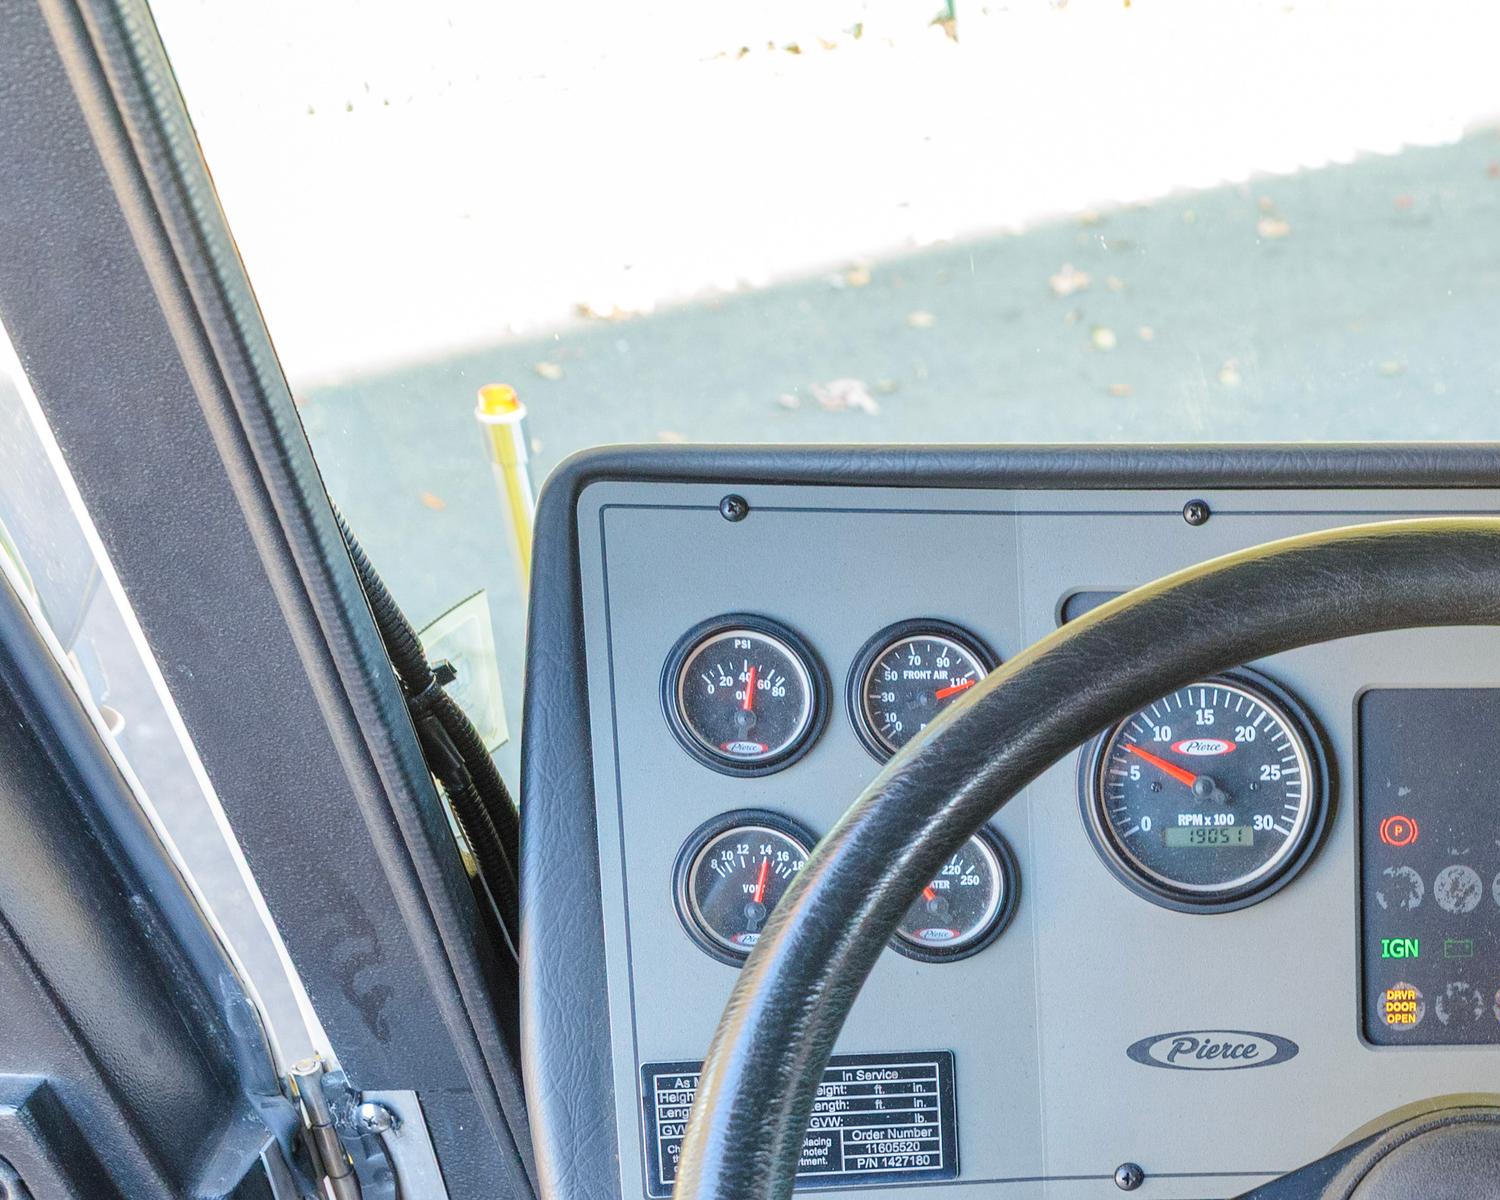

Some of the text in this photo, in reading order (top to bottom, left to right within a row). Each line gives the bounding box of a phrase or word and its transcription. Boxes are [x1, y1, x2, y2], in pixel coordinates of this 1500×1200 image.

[735, 640, 751, 649] PSI
[908, 656, 921, 666] 70
[936, 657, 950, 667] 90
[885, 671, 898, 681] 50
[903, 670, 948, 680] FRONT AIR
[719, 676, 733, 687] 20
[757, 680, 771, 690] 60
[707, 684, 715, 694] 0
[771, 686, 785, 697] 80
[882, 692, 895, 702] 30
[884, 713, 897, 723] 10
[1195, 708, 1214, 726] 15
[895, 721, 902, 732] 0
[1152, 725, 1172, 742] 10
[1235, 726, 1256, 742] 20
[1130, 765, 1141, 781] 5
[1260, 764, 1281, 781] 25
[1141, 815, 1151, 832] 0
[1178, 813, 1235, 827] RPM x 100
[1253, 814, 1274, 831] 30
[1394, 825, 1403, 837] P
[1190, 829, 1243, 845] 19051
[737, 844, 749, 855] 12
[760, 844, 772, 855] 14
[721, 851, 734, 861] 10
[777, 851, 789, 862] 16
[711, 859, 718, 870] 8
[792, 861, 805, 871] 18
[942, 865, 961, 876] 220
[930, 880, 950, 889] ATER
[961, 875, 980, 886] 250
[1381, 939, 1419, 959] IGN
[1386, 990, 1416, 1001] DRVR
[1385, 1002, 1417, 1012] DOOR
[1386, 1013, 1416, 1024] OPEN
[1167, 1037, 1259, 1062] Pierce
[842, 1069, 899, 1082] In Service
[674, 1078, 690, 1090] As
[817, 1082, 926, 1097] eight: ft. in.
[812, 1097, 927, 1113] ength: ft. in.
[810, 1112, 928, 1128] GVW: lb.
[852, 1127, 932, 1141] Order Number
[803, 1147, 828, 1156] noted
[866, 1141, 920, 1154] 11605520
[857, 1154, 930, 1169] P/N 1427180
